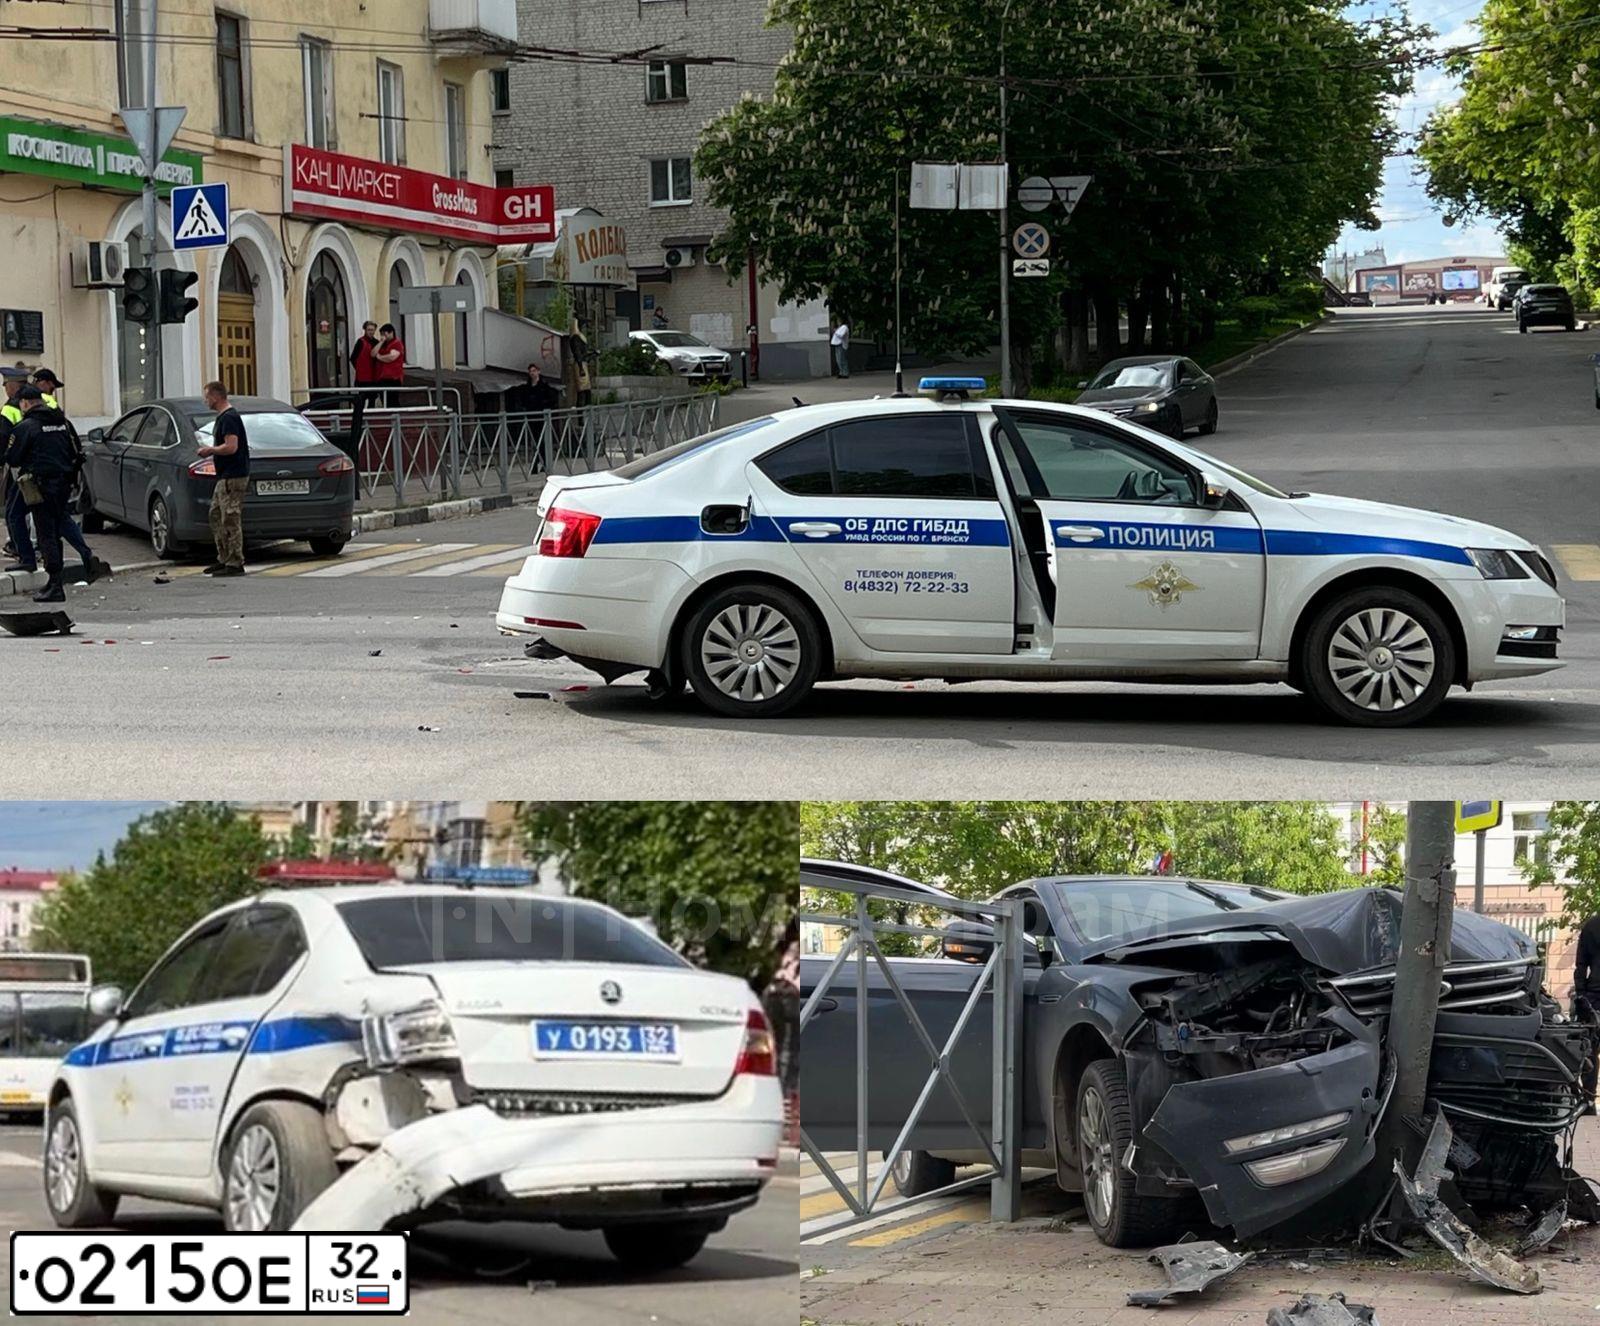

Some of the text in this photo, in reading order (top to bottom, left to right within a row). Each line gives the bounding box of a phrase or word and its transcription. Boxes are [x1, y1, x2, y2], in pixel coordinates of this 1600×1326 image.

[8, 133, 193, 185] КОСМЕТИКА ПАРФМЕРИЯ
[295, 155, 401, 199] КАНЦМАРКЕТ
[432, 182, 478, 216] GrossHaus
[503, 194, 542, 220] GH
[844, 533, 869, 542] УМВД
[871, 534, 906, 542] РОССИИ
[931, 535, 969, 543] БРЯНСКУ
[845, 518, 970, 534] ОБ ДПС ГИБДД
[1108, 526, 1216, 550] ПОЛИЦИЯ
[844, 580, 969, 594] 8(4832) 72-22-33
[856, 569, 957, 581] ТЕЛЕФОН ДОВЕРИЯ:
[569, 1026, 632, 1050] 0193
[645, 1026, 669, 1046] 32
